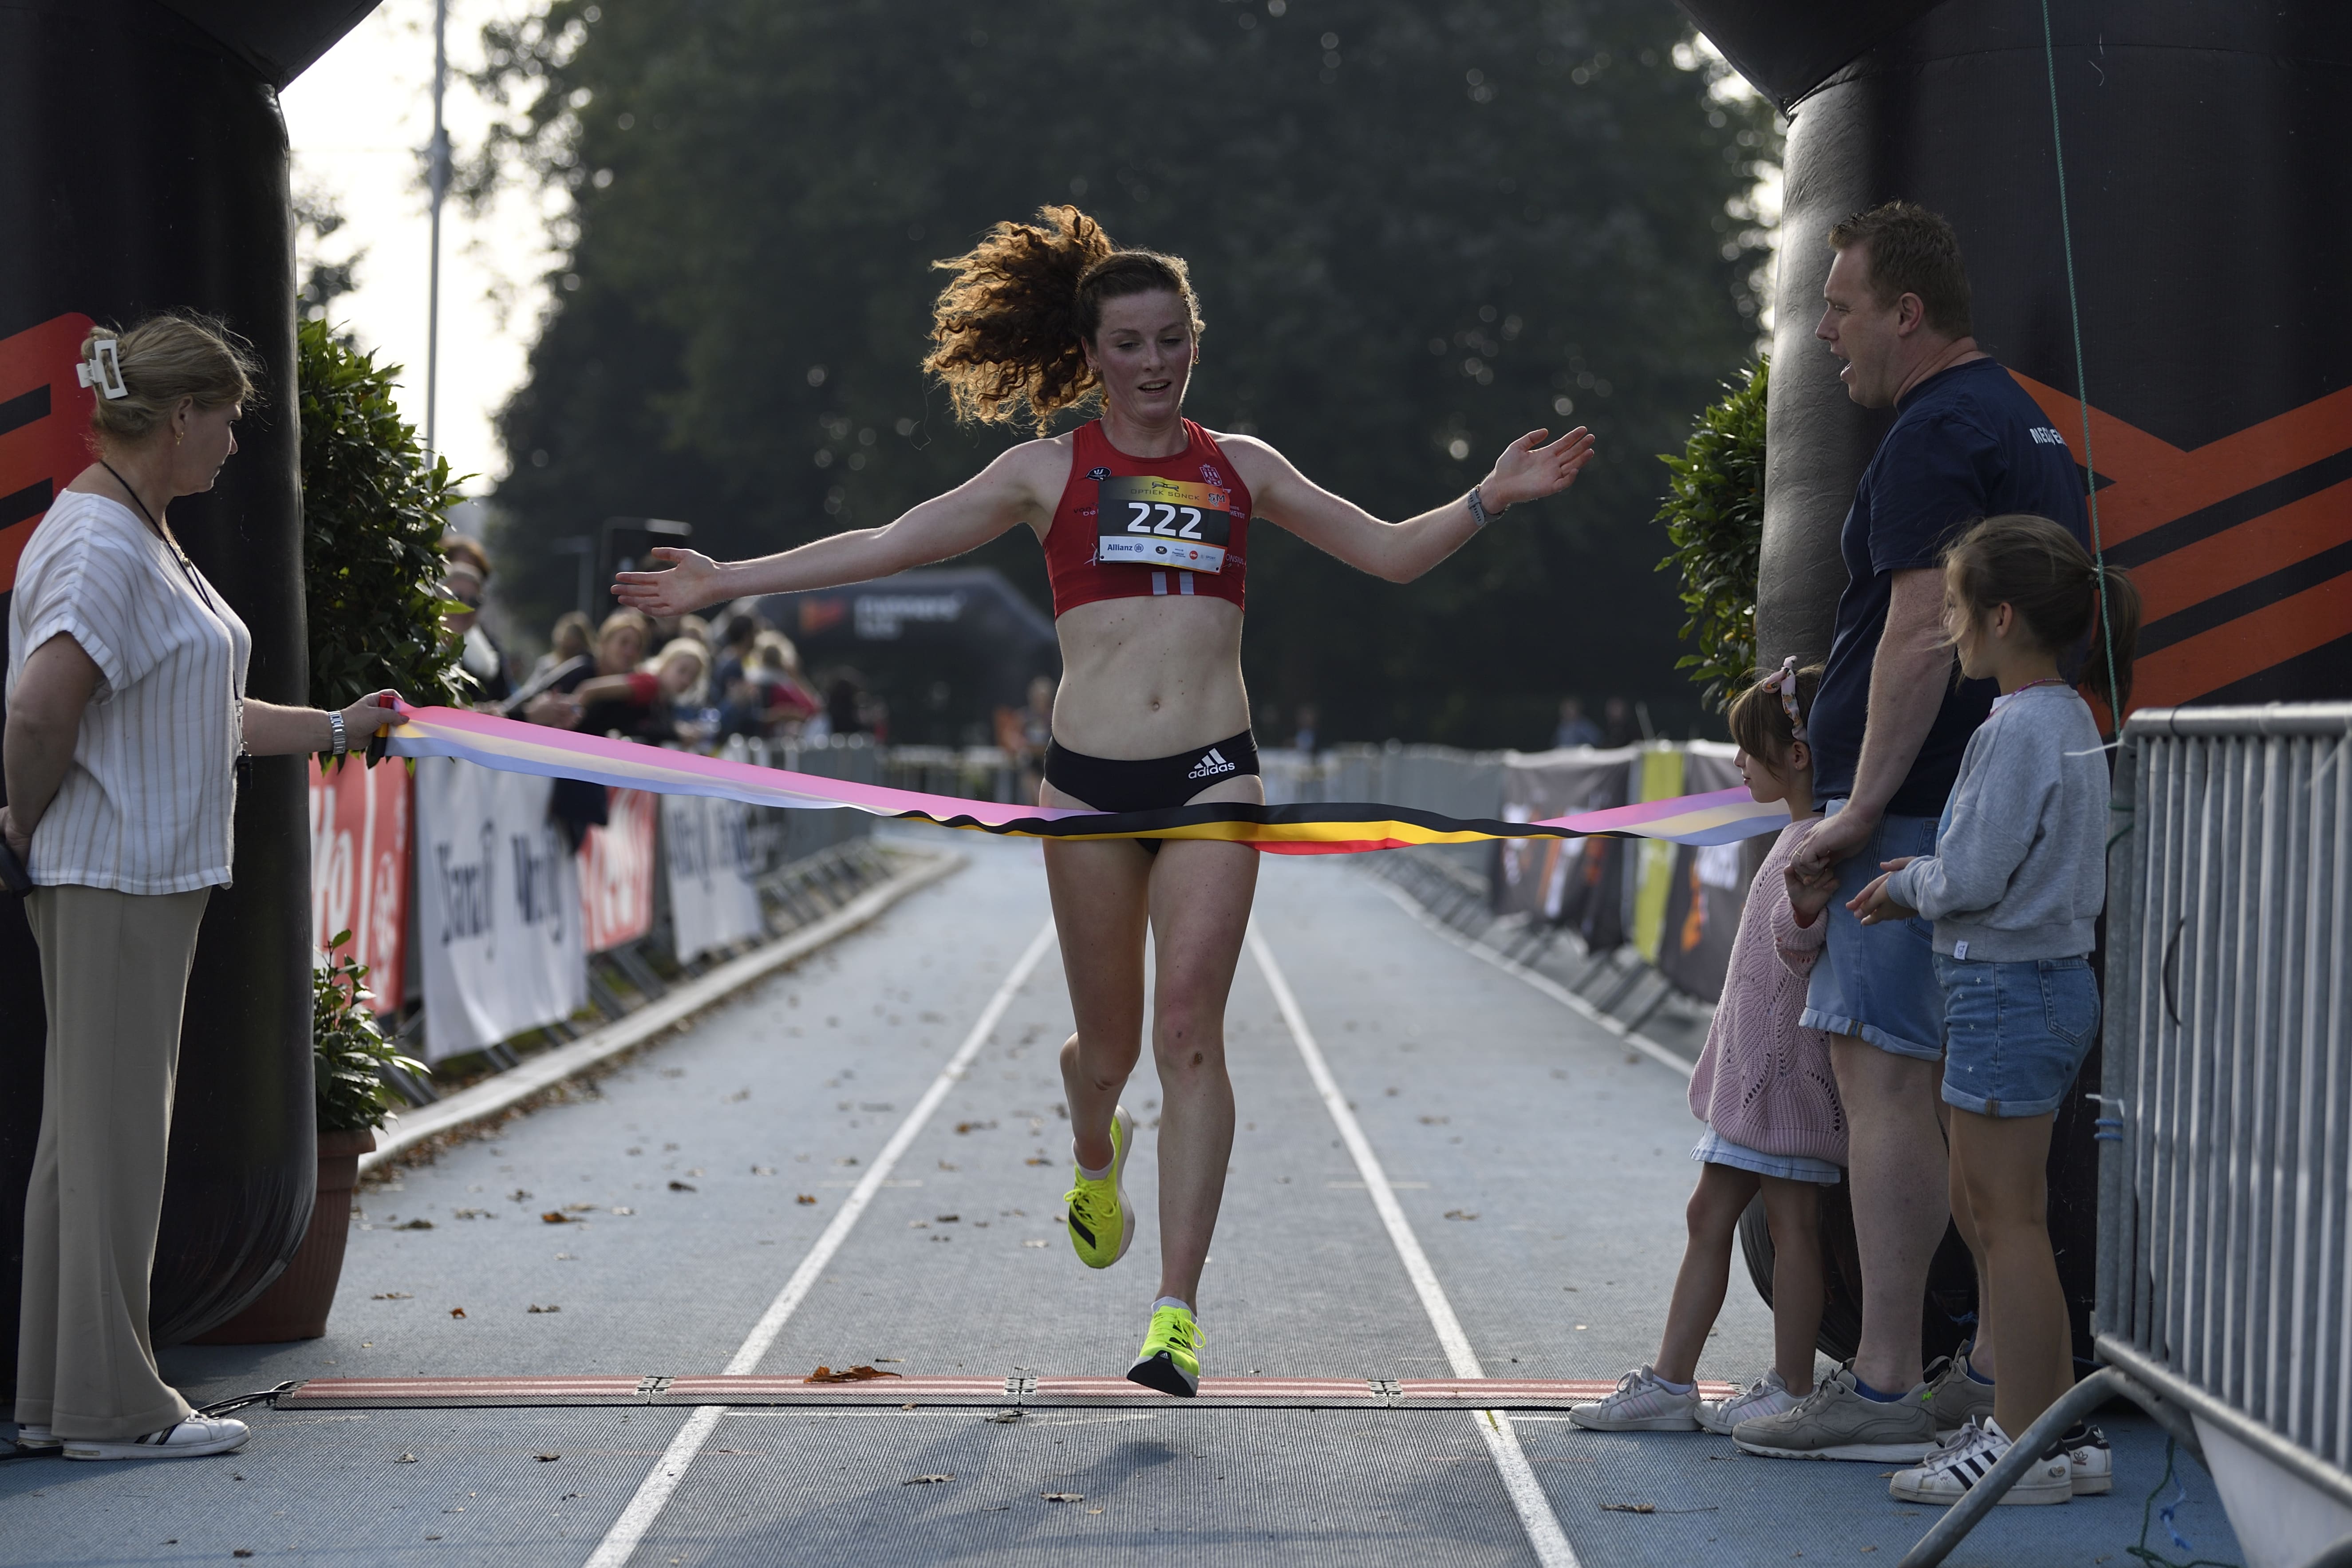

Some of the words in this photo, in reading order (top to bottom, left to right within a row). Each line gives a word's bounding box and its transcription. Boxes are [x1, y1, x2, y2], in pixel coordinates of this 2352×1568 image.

[1168, 491, 1200, 501] SONCK
[1127, 502, 1202, 540] 222
[1229, 510, 1245, 519] HEYDT
[1188, 762, 1235, 779] adidas
